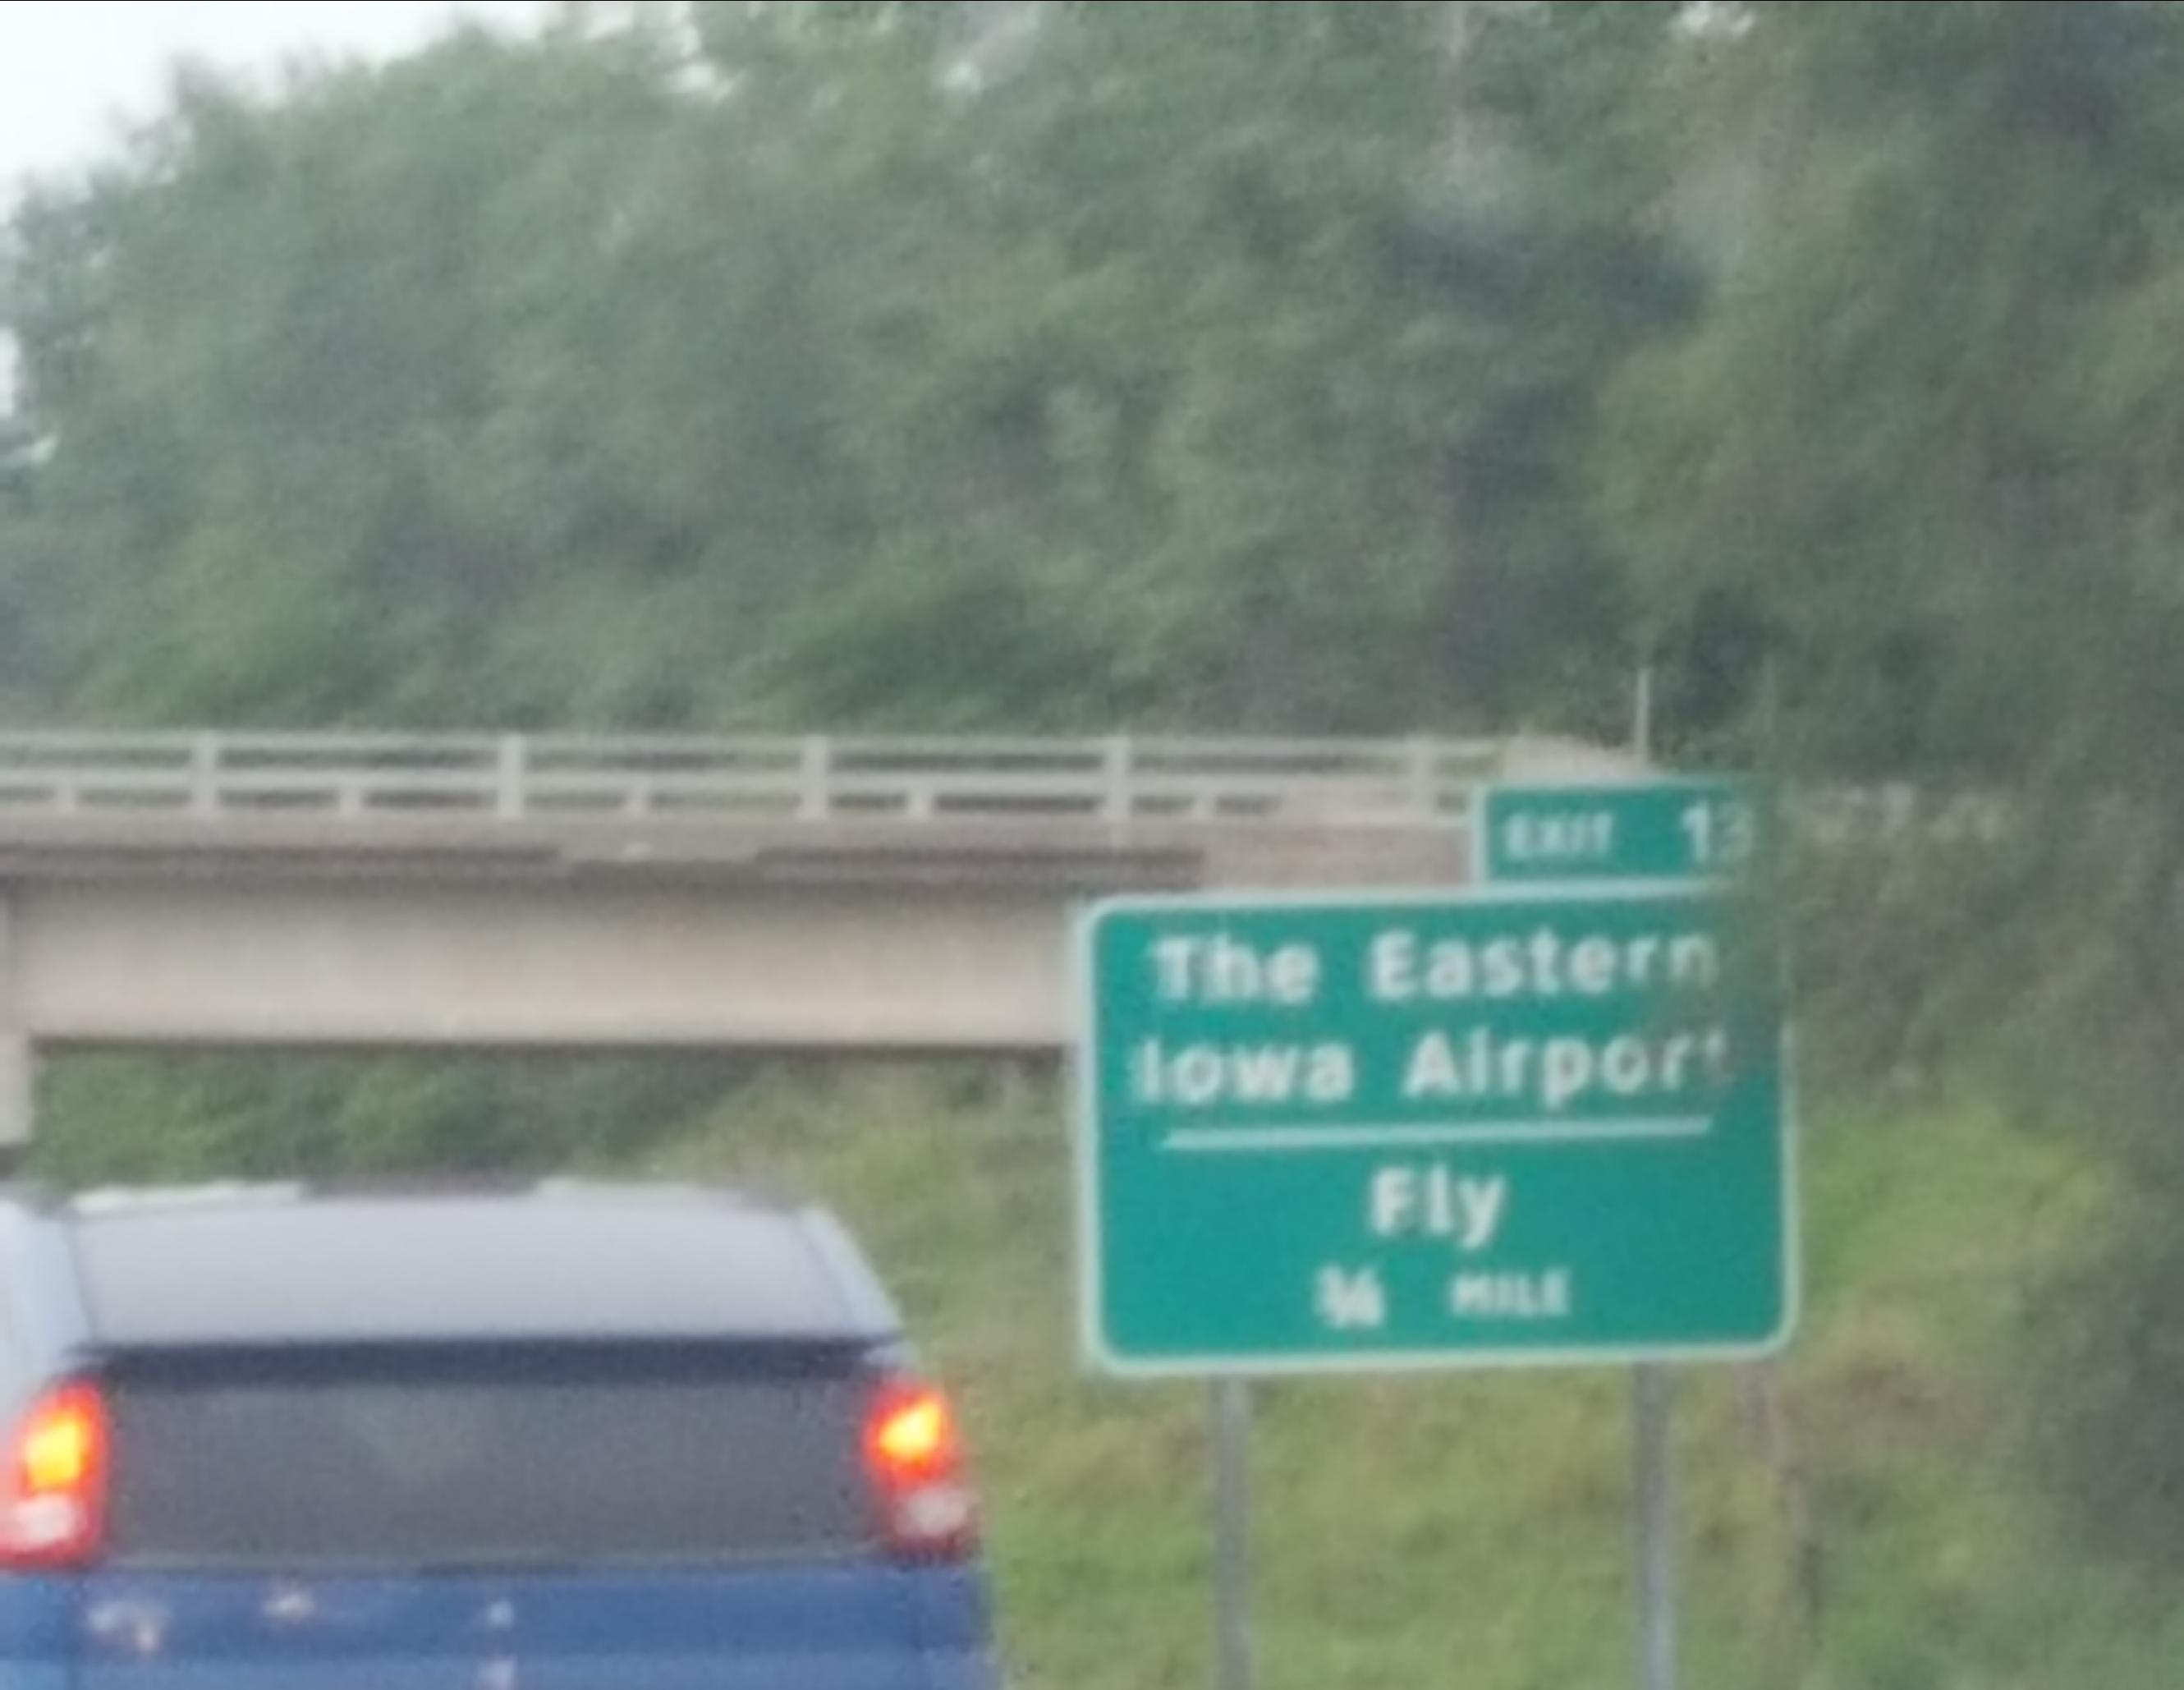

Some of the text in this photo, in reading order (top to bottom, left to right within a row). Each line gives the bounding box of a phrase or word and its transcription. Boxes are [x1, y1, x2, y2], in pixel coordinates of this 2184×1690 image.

[1505, 811, 1616, 861] EXIT
[1151, 925, 1721, 1003] The Eastern
[1132, 1036, 1355, 1105] Iowa
[1370, 1164, 1509, 1250] Fly
[1448, 1267, 1571, 1318] MILE
